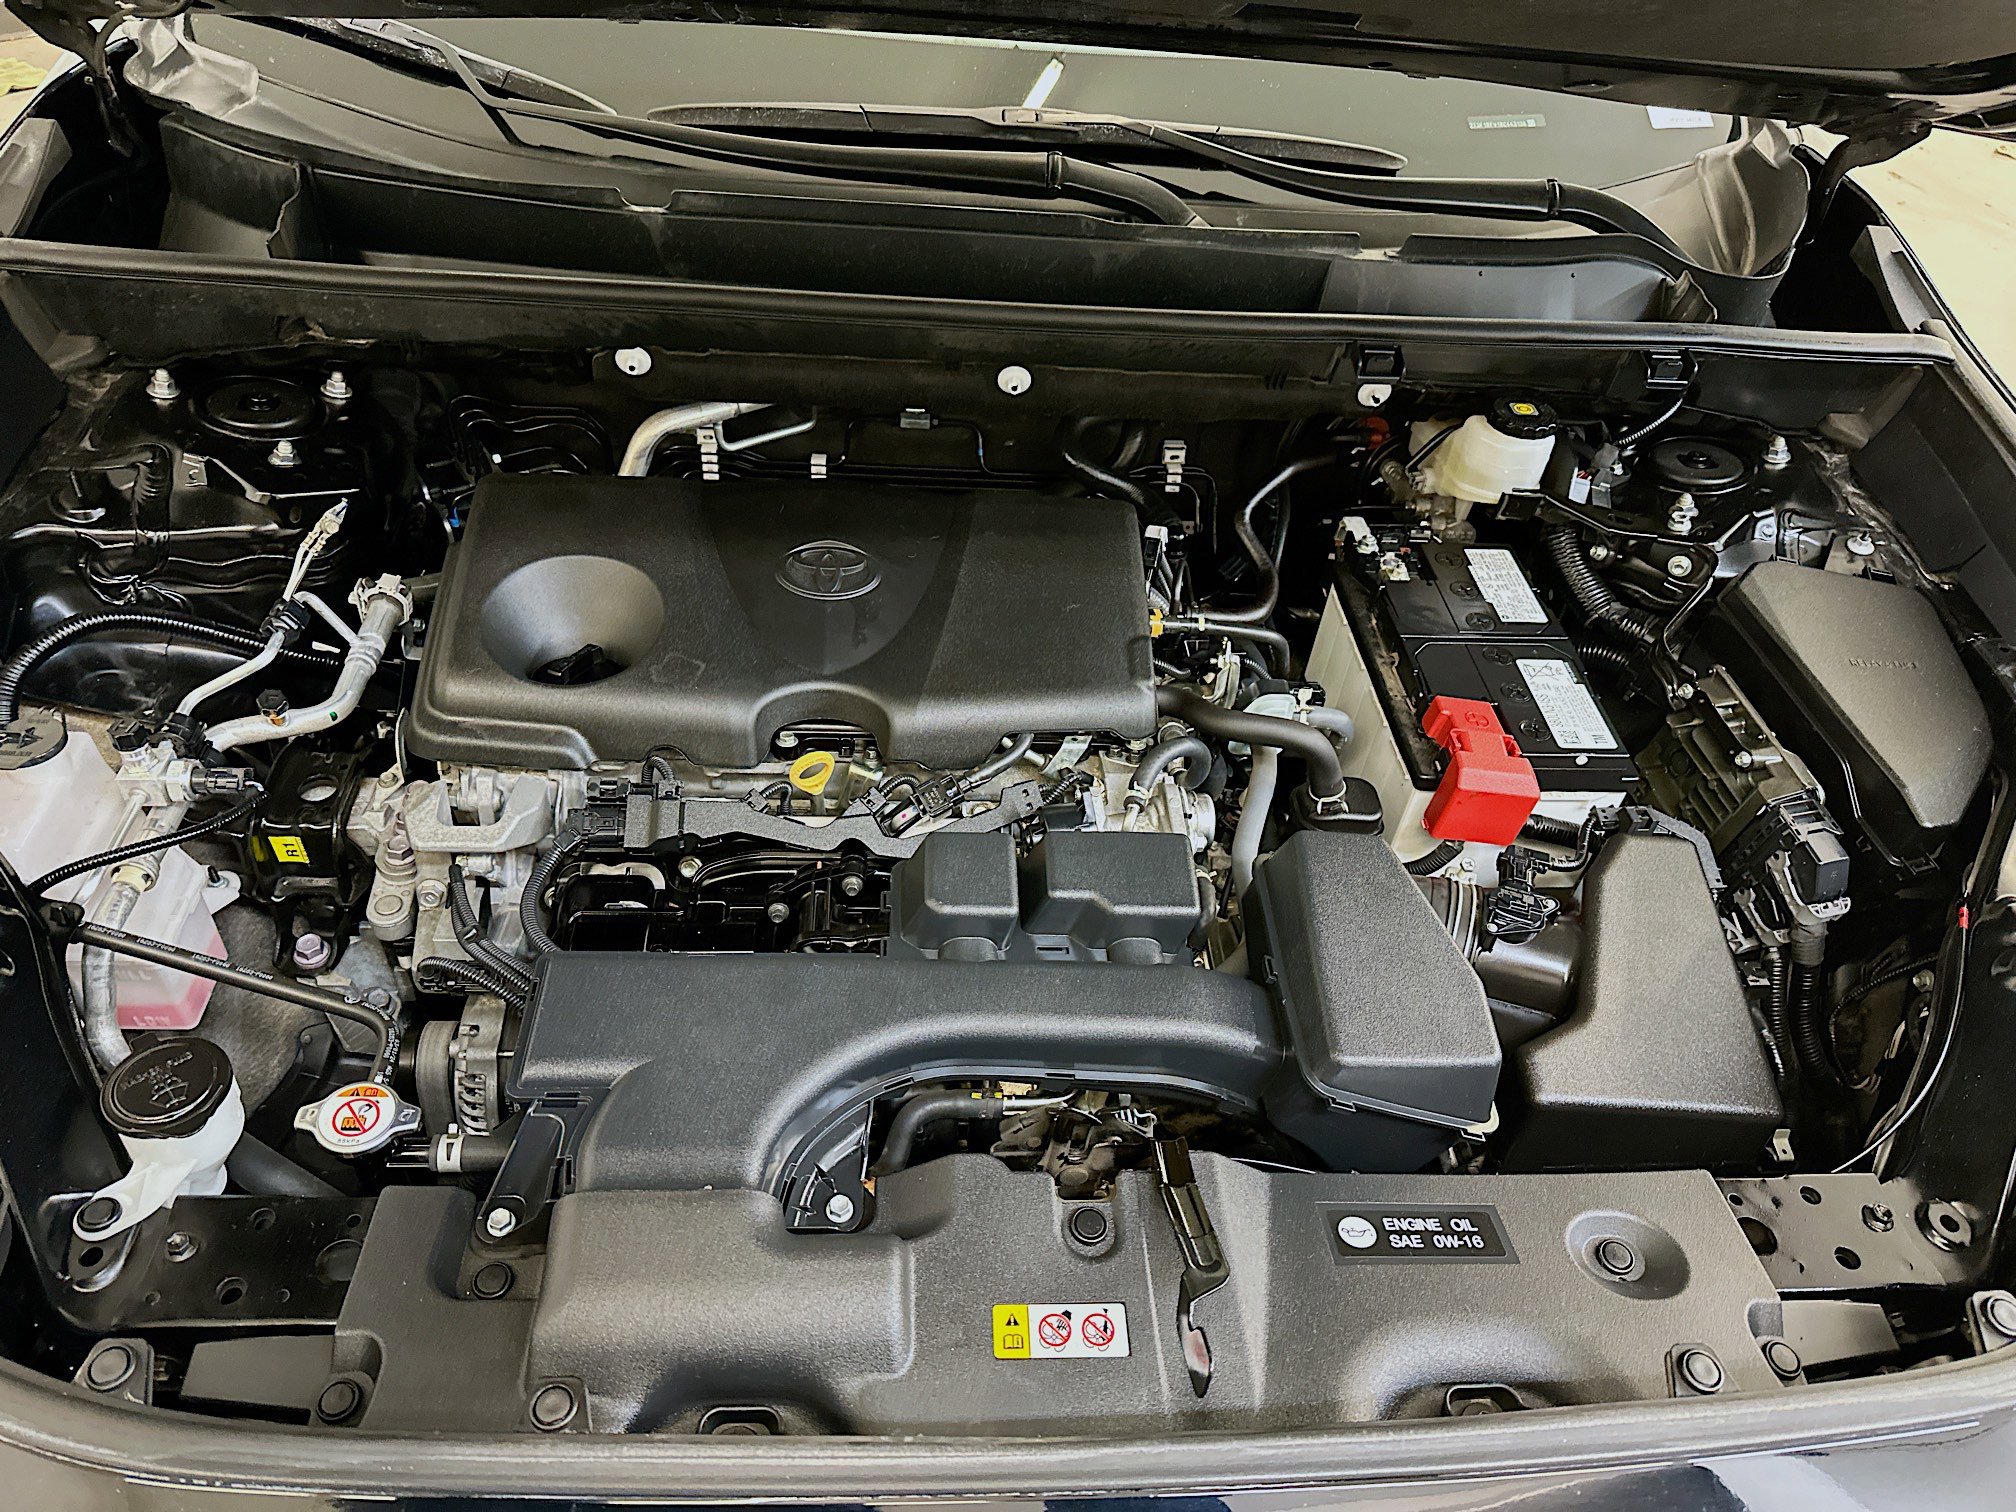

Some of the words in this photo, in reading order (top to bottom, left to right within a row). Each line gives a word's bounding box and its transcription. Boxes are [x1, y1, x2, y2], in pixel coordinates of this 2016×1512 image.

[1848, 658, 1881, 667] RELAY
[282, 843, 300, 857] R1
[1382, 1217, 1443, 1231] ENGINE
[1450, 1218, 1479, 1232] OIL
[1389, 1234, 1425, 1248] SAE
[1432, 1234, 1485, 1248] 0W-16
